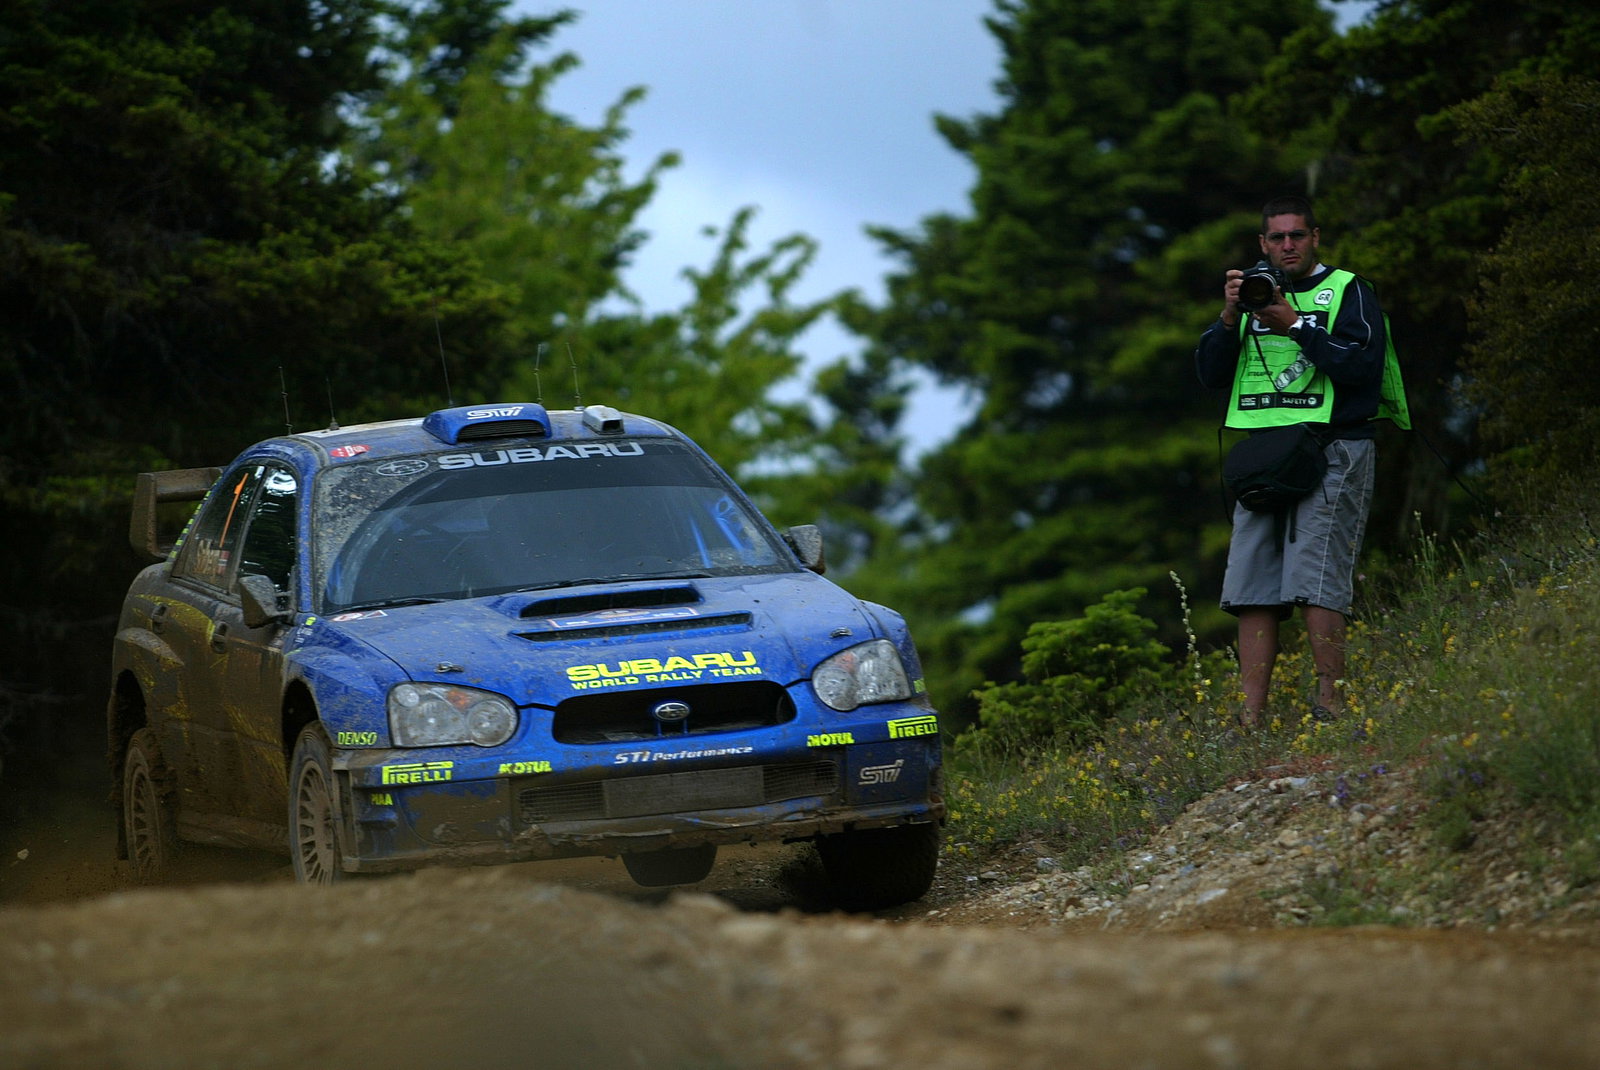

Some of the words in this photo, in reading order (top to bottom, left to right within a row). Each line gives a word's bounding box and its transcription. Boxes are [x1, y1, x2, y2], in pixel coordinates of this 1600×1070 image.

[1281, 397, 1307, 405] SAFETY
[438, 441, 645, 470] SUBARU
[567, 651, 757, 681] SUBARU
[571, 675, 639, 690] WORLD
[647, 669, 704, 684] RALLY
[710, 666, 763, 678] TEAM
[337, 731, 378, 746] DENSO
[806, 731, 855, 747] MOTUL
[887, 715, 939, 739] PIRELLI
[652, 745, 754, 762] Performance
[381, 760, 454, 785] PIRELLI
